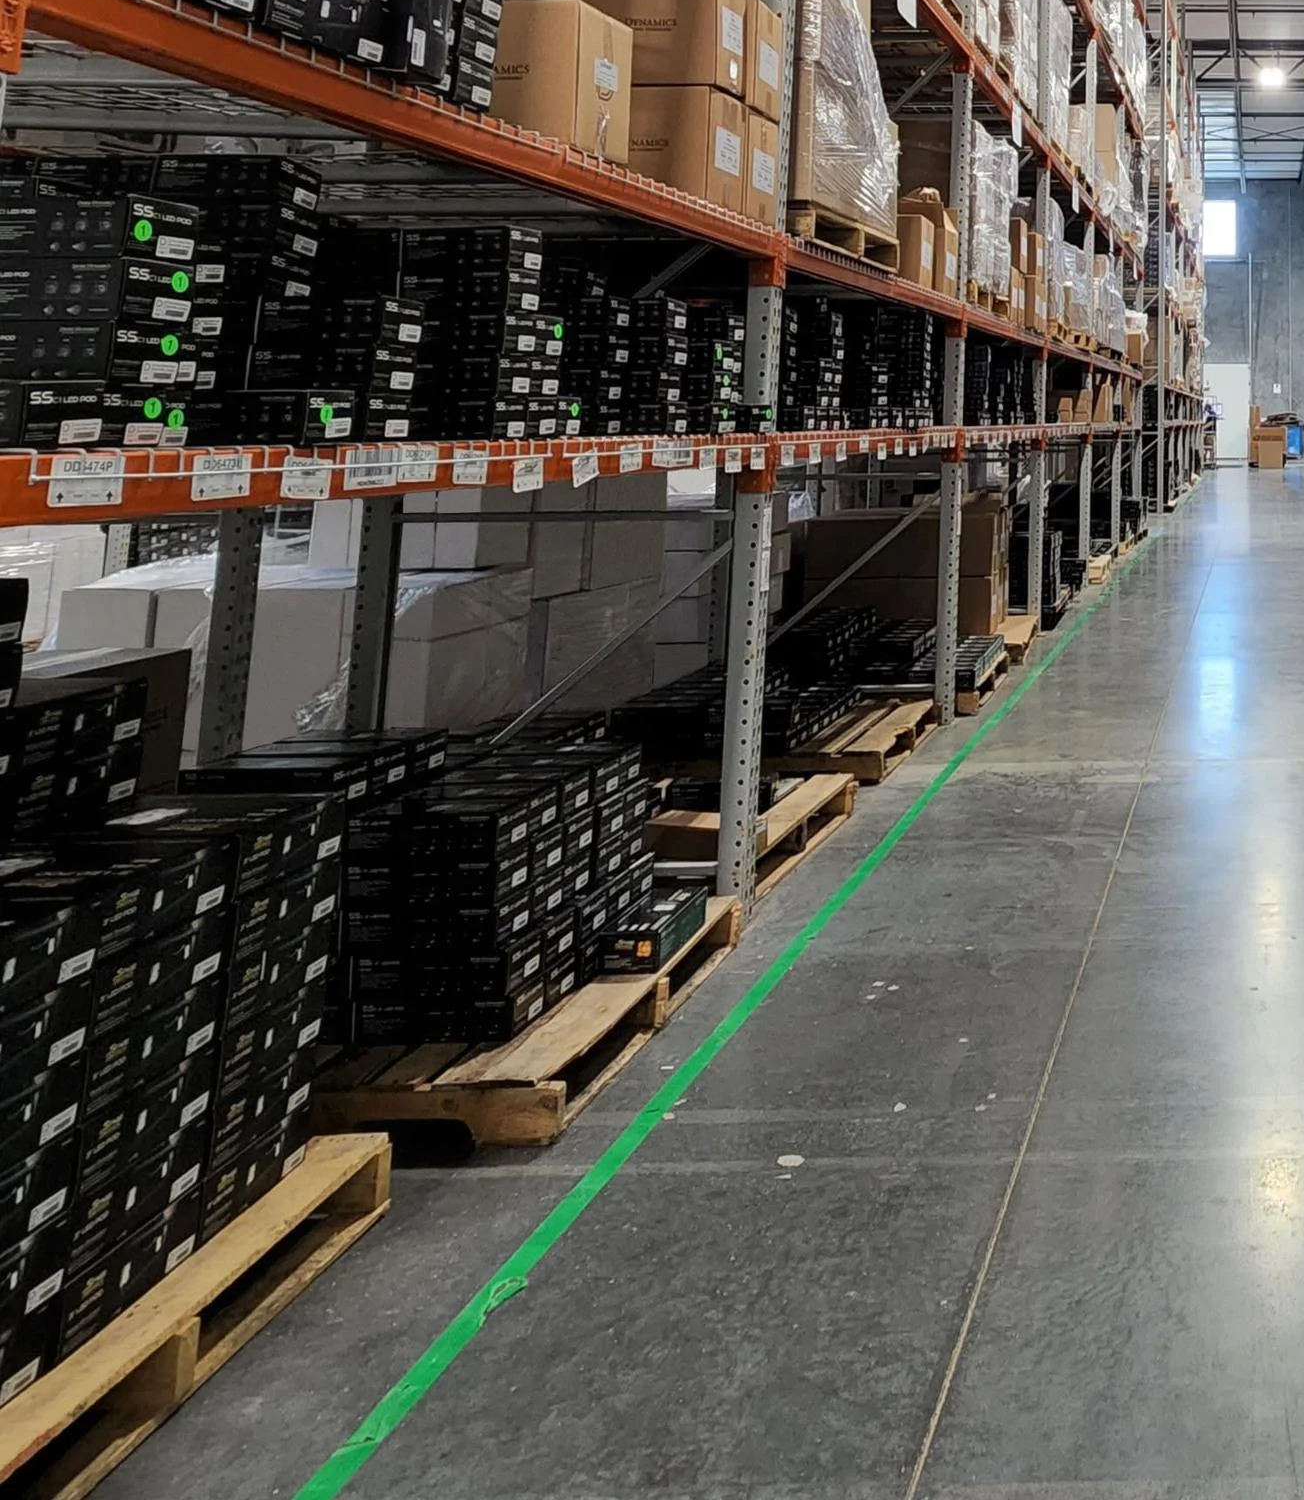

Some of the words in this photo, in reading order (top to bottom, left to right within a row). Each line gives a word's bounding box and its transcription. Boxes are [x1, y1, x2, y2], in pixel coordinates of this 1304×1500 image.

[627, 17, 678, 27] DYNAMICS
[493, 64, 530, 75] AMICS
[631, 138, 669, 148] NAMICS
[162, 213, 175, 223] LED
[176, 216, 193, 226] POD
[146, 337, 161, 345] LED
[63, 395, 78, 403] LED
[79, 395, 98, 403] POD
